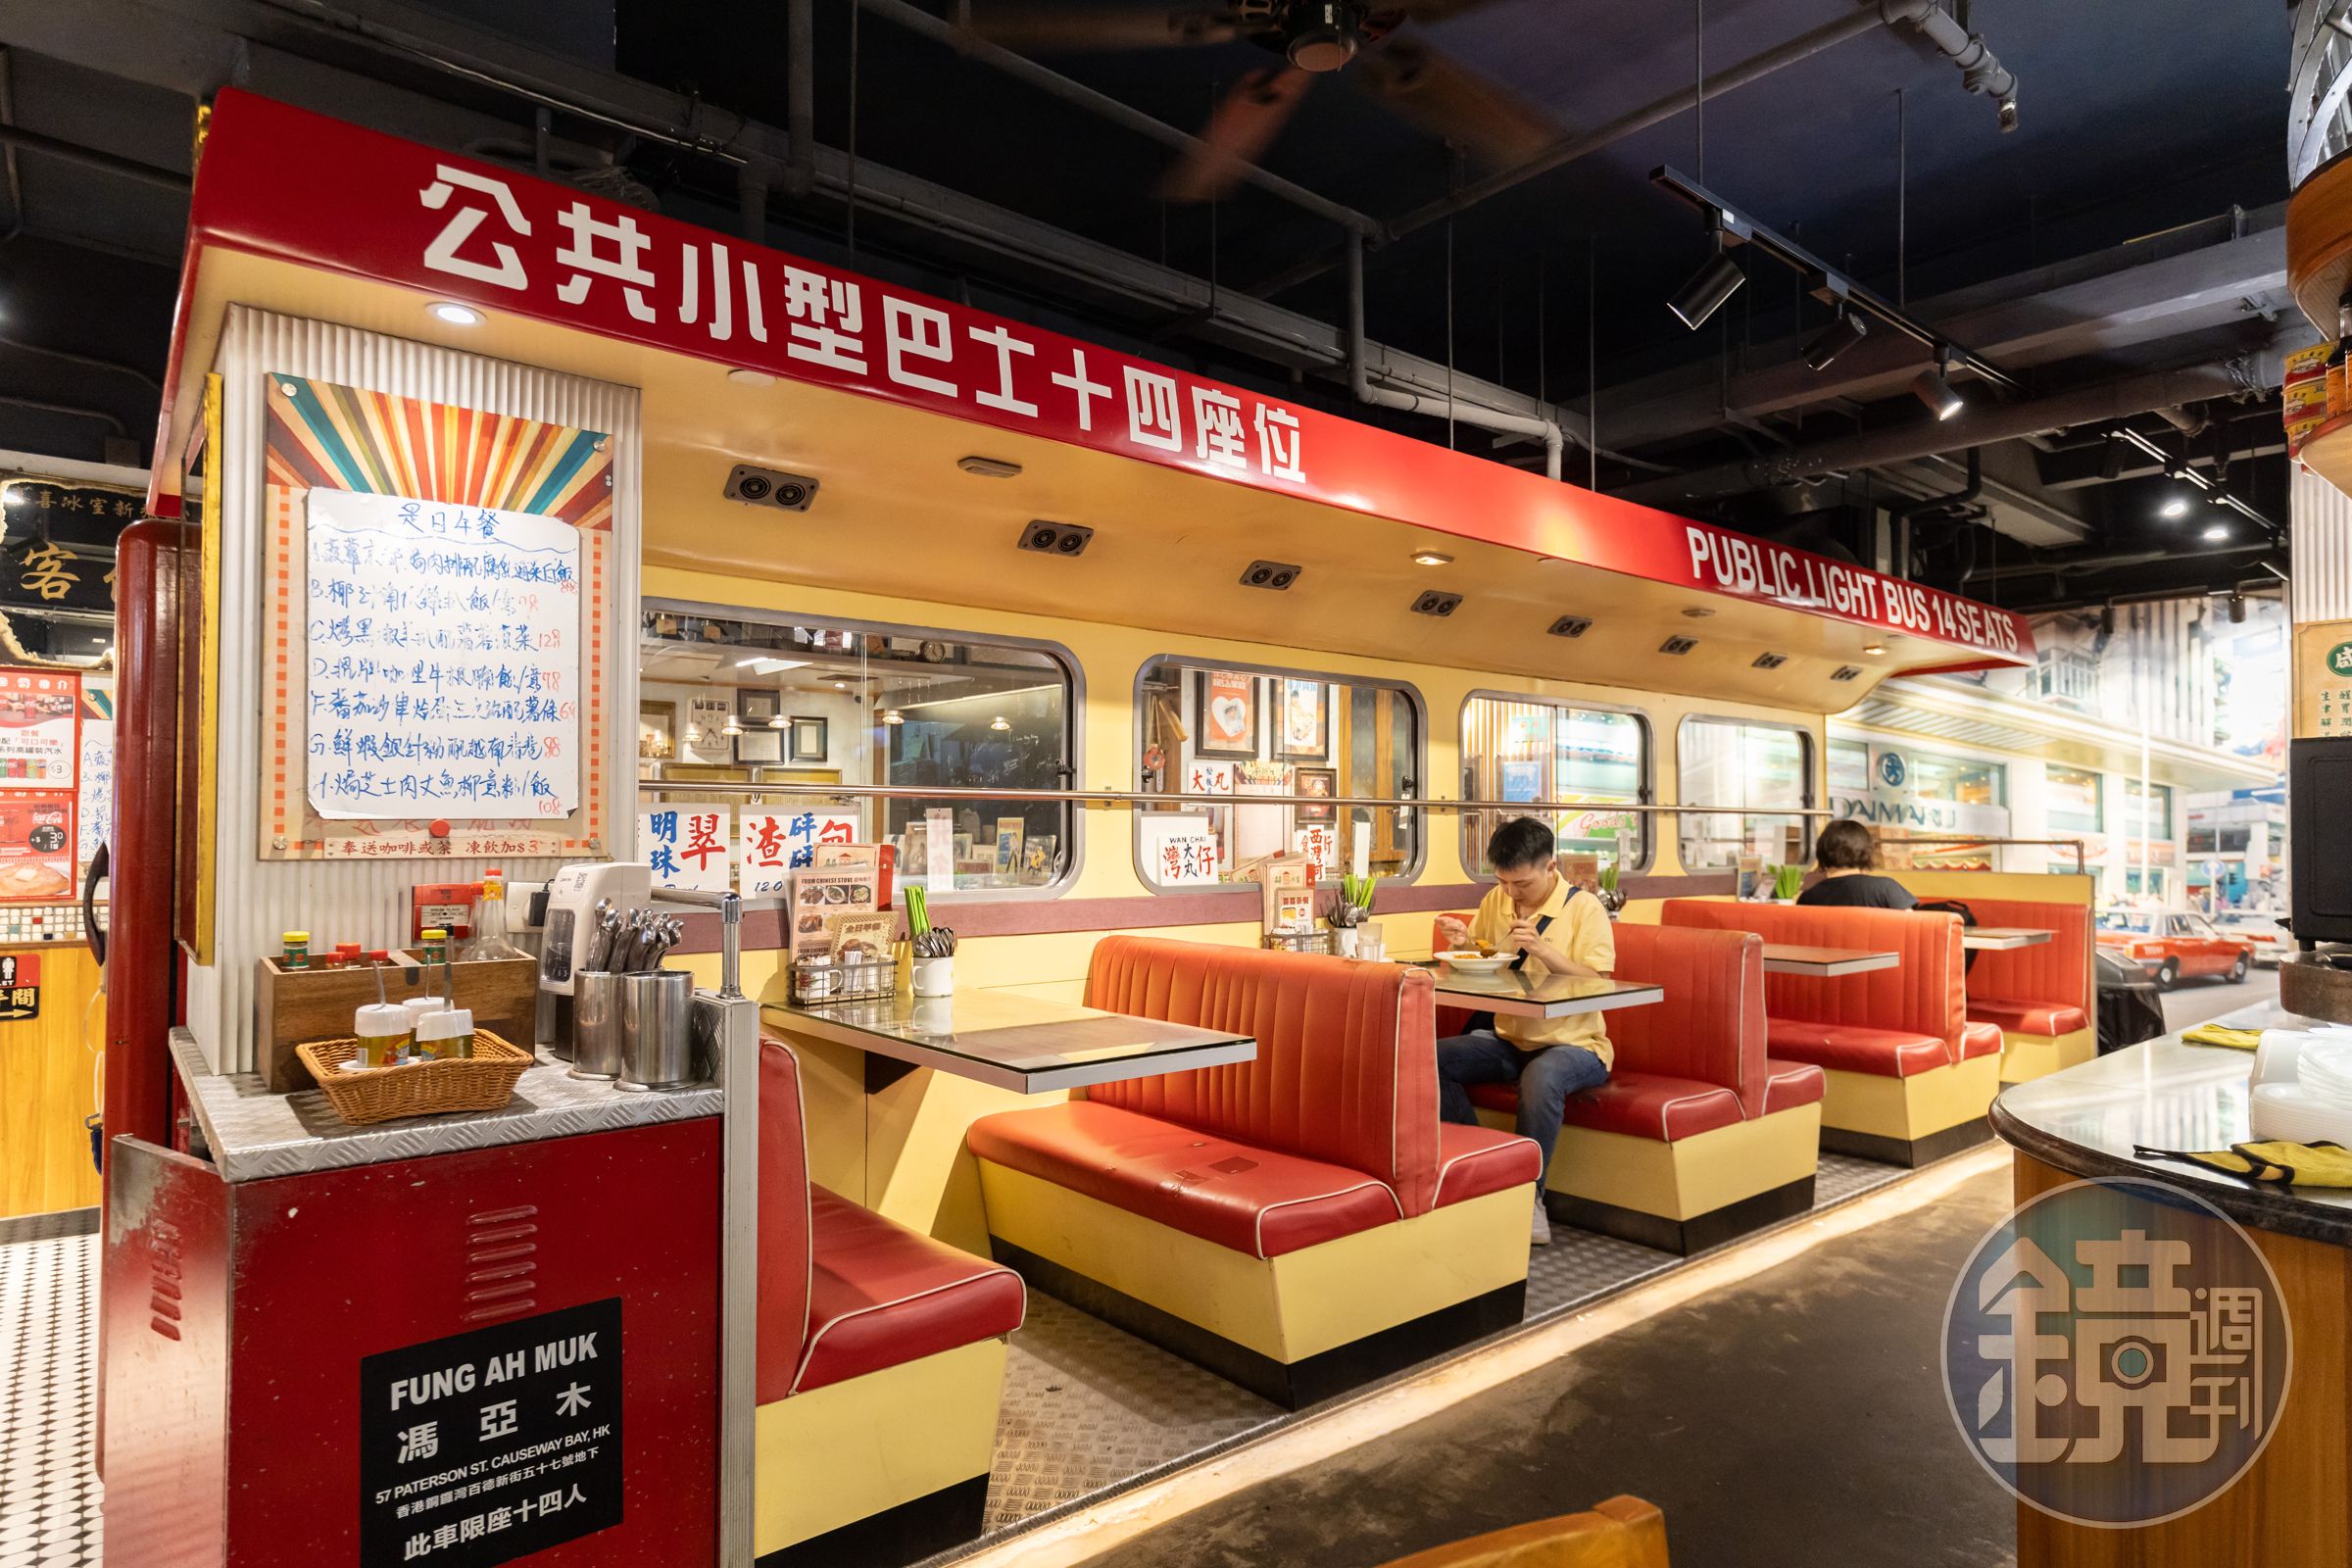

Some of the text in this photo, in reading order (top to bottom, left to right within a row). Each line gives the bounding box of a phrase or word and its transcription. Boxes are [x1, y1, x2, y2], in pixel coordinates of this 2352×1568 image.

[419, 164, 1305, 483] 公共小型巴士十四座位
[398, 502, 500, 538] 是日午餐
[1686, 526, 2019, 654] PUBLIC LIGHT BUS 14 SEATS
[343, 840, 452, 856] 奉送咖啡或茶
[650, 809, 682, 879] 明珠
[680, 813, 726, 872] 翠
[1183, 843, 1198, 878] 大丸
[391, 1332, 598, 1411] FUNG AH MUK
[375, 1423, 611, 1504] 57 PATERSON ST. CAUSEWAY BAY, HK
[395, 1446, 600, 1519] 香港銅鑼灣百德新街五十七號地下
[403, 1483, 588, 1561] 此車限座十四人
